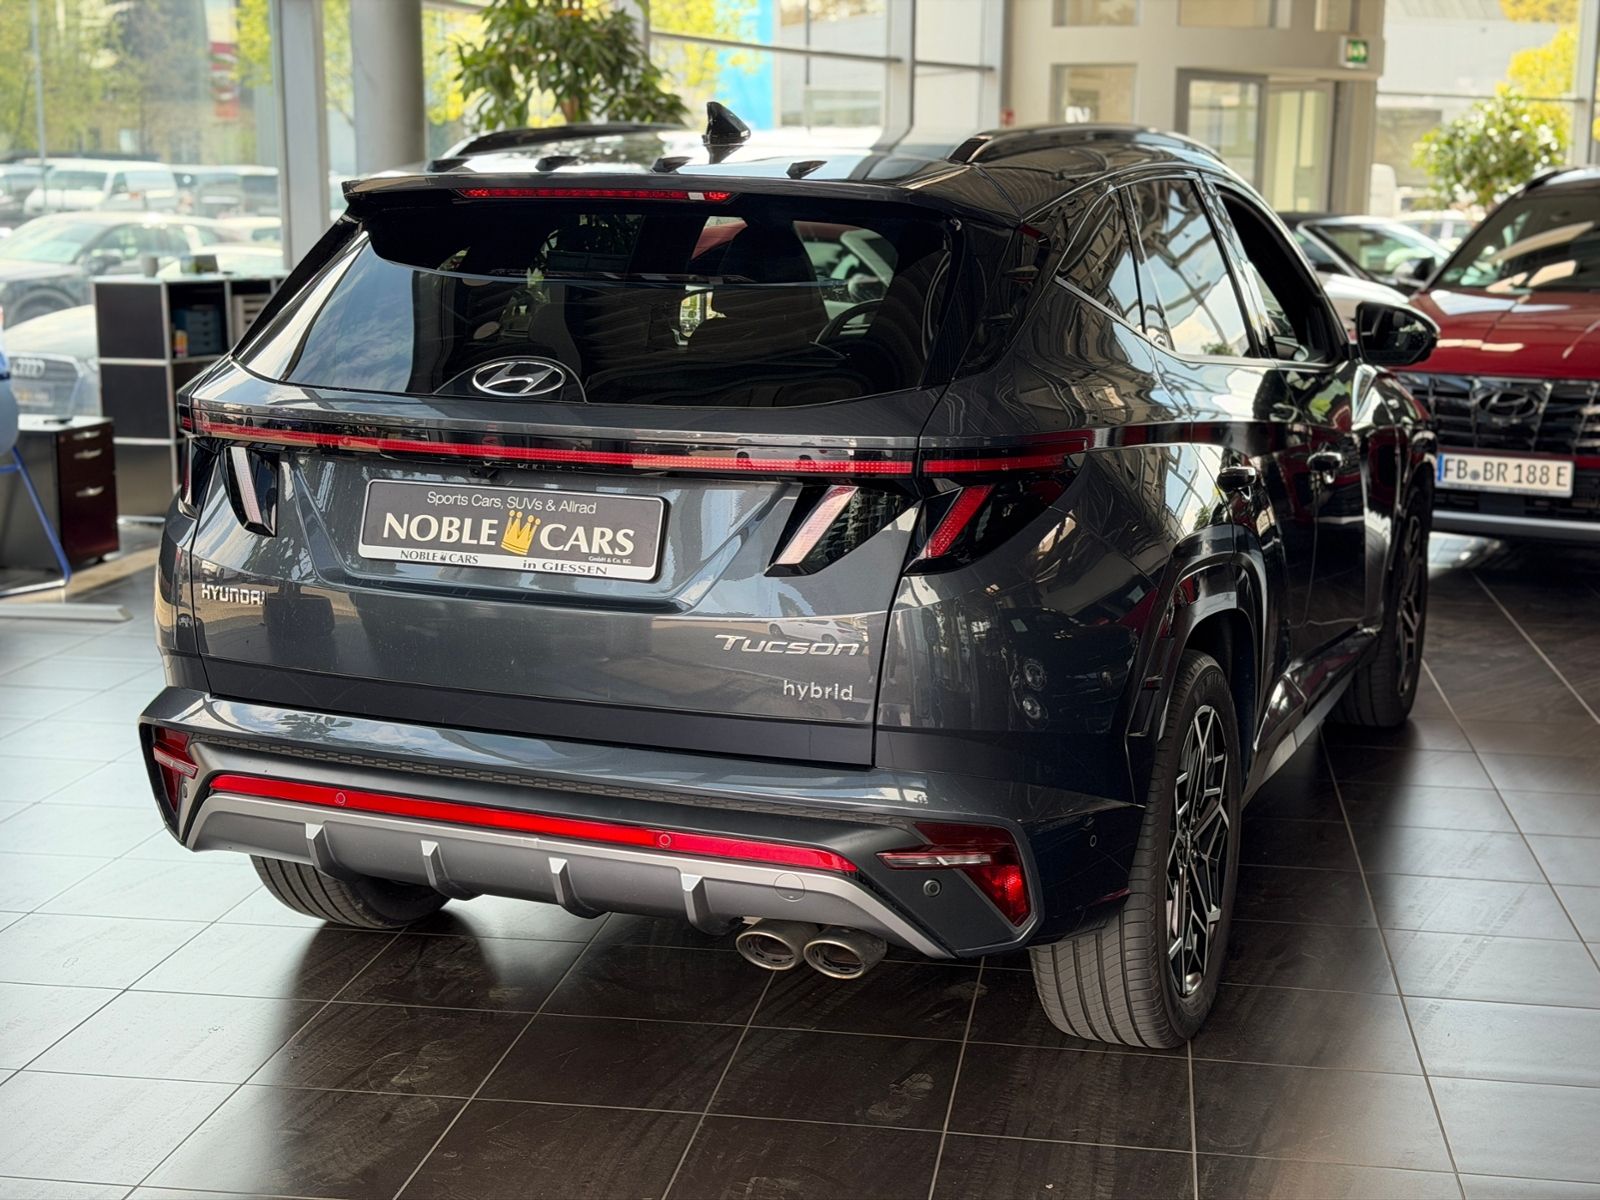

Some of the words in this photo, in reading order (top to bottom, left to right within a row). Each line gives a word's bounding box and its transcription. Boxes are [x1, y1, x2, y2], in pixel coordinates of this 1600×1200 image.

[1443, 459, 1468, 480] FB
[1483, 461, 1508, 482] BR
[427, 491, 468, 506] Sports
[472, 494, 504, 509] Cars,
[507, 496, 543, 511] SUVs
[545, 500, 556, 512] &
[559, 500, 597, 514] Allrad
[383, 512, 499, 546] NOBLE
[540, 523, 635, 556] CARS
[400, 549, 438, 561] NOBLE
[449, 553, 479, 564] CARS
[522, 560, 536, 569] in
[542, 561, 608, 575] GIESSEN
[201, 583, 266, 606] HYUNDAI
[783, 680, 854, 701] hybrid
